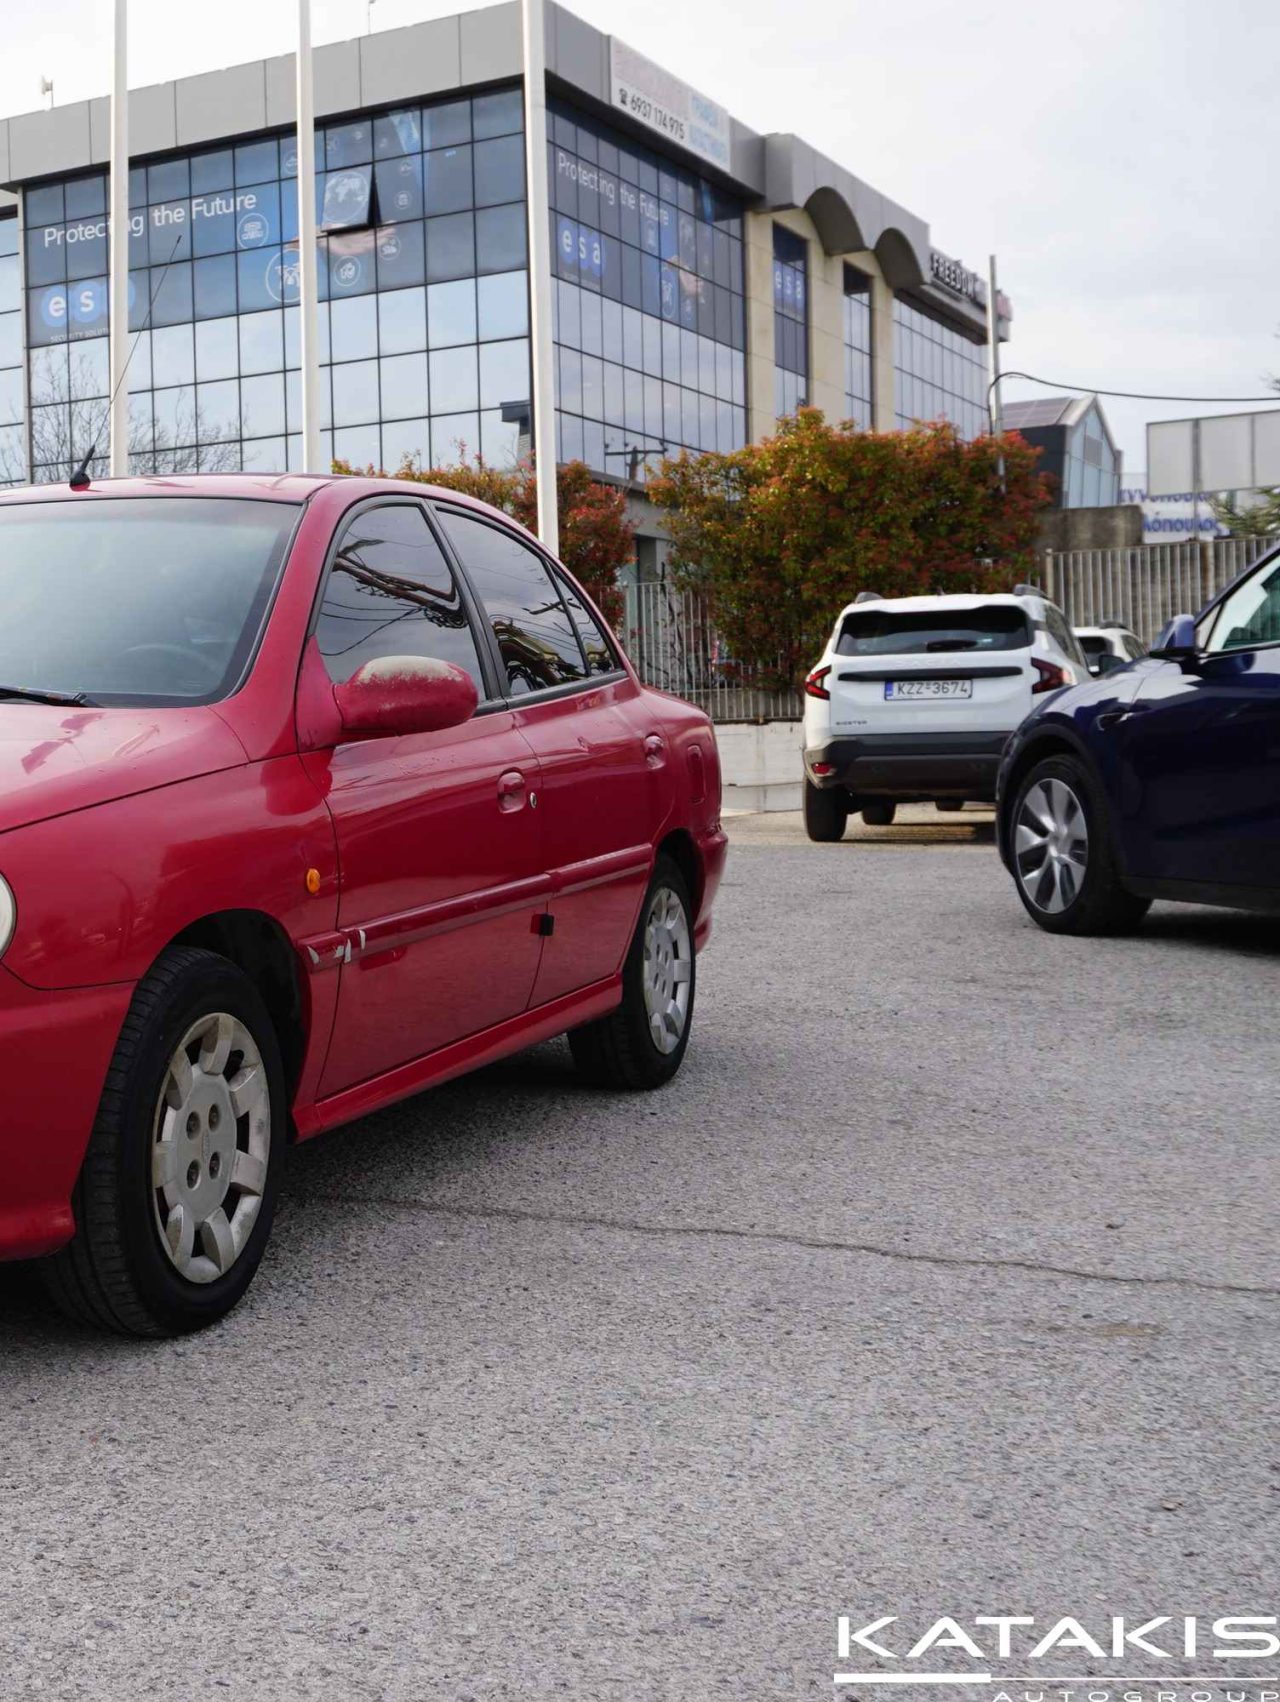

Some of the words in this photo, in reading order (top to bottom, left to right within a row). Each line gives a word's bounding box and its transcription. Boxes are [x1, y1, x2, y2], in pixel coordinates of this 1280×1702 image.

[558, 151, 615, 206] Protecting
[620, 186, 636, 210] the
[640, 194, 669, 226] Future
[152, 205, 185, 227] the
[192, 194, 257, 219] Future
[562, 229, 601, 264] esa
[775, 270, 802, 299] esa
